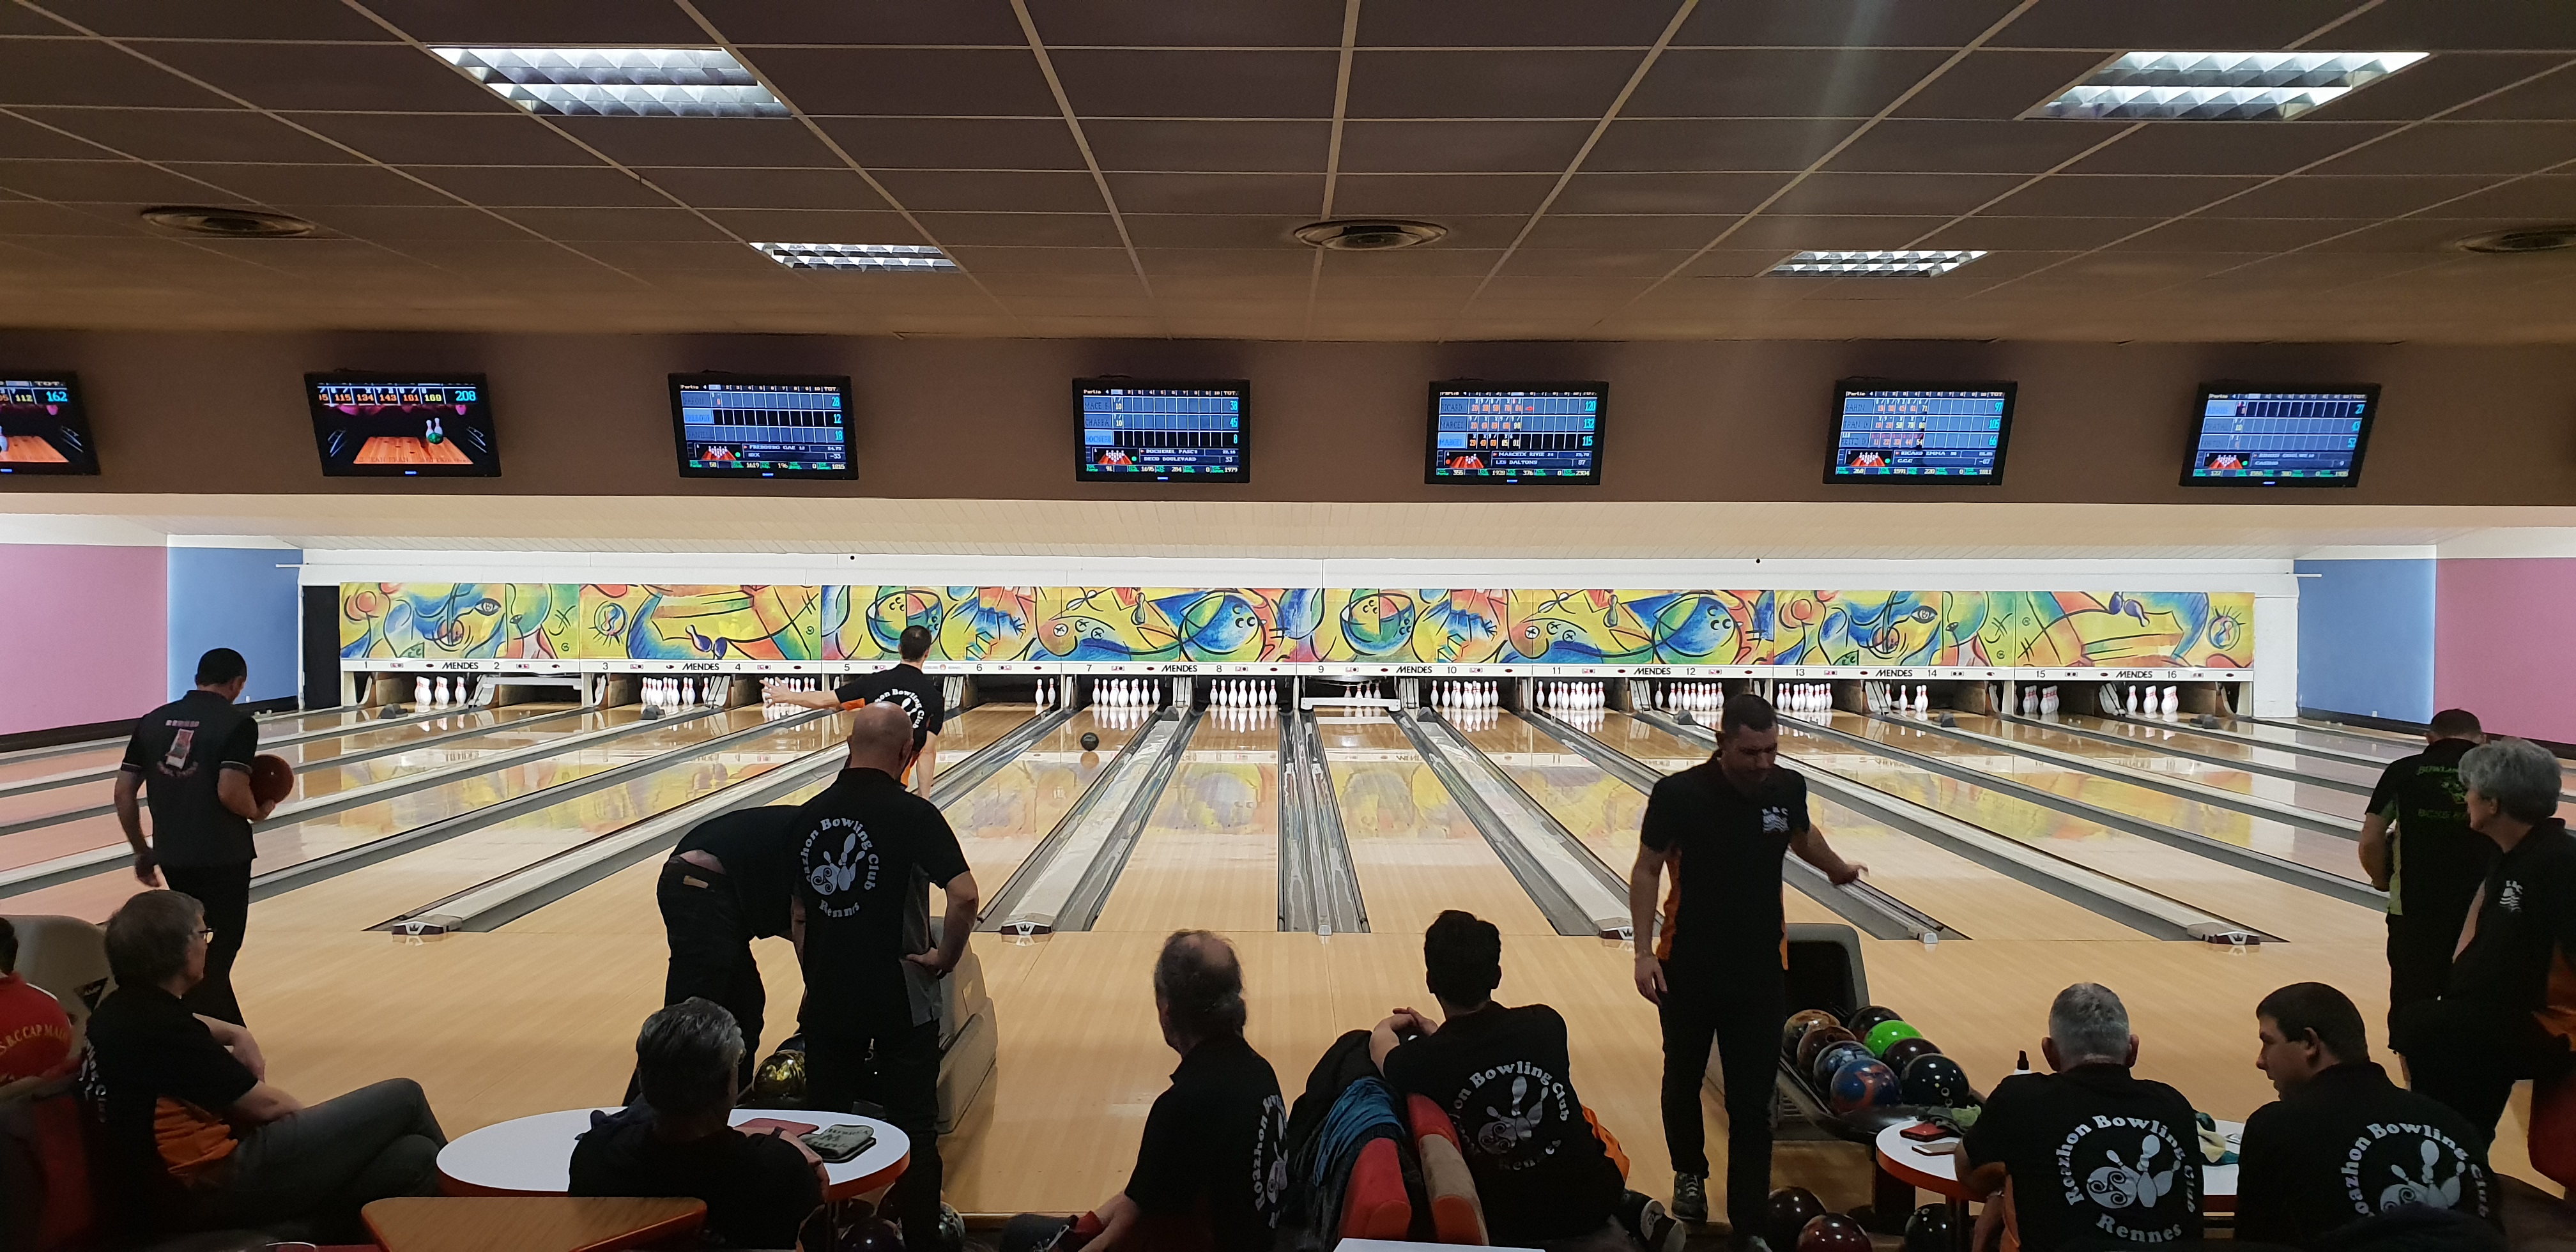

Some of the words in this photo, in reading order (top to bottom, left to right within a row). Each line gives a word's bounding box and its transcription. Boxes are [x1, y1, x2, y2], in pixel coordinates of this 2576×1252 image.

[15, 394, 33, 402] 112
[47, 391, 68, 402] 162
[455, 390, 476, 401] 208
[1585, 401, 1596, 411] 120
[1995, 402, 2003, 412] 97
[834, 414, 841, 424] 12
[1230, 417, 1238, 427] 45
[1583, 418, 1594, 429] 132
[835, 431, 843, 440] 18
[1583, 436, 1593, 446] 115
[1875, 669, 1913, 677] MENDES
[892, 689, 923, 708] Bowling
[912, 710, 924, 729] Club
[820, 818, 873, 850] Bowling
[864, 853, 880, 890] Club
[1469, 1060, 1553, 1088] Bowling
[1552, 1082, 1570, 1121] Club
[2056, 1124, 2092, 1205] Roazhon
[2092, 1115, 2186, 1160] Bowling
[2340, 1136, 2375, 1217] oazhon
[2366, 1123, 2469, 1161] Bowling
[2096, 1212, 2182, 1242] Rennes
